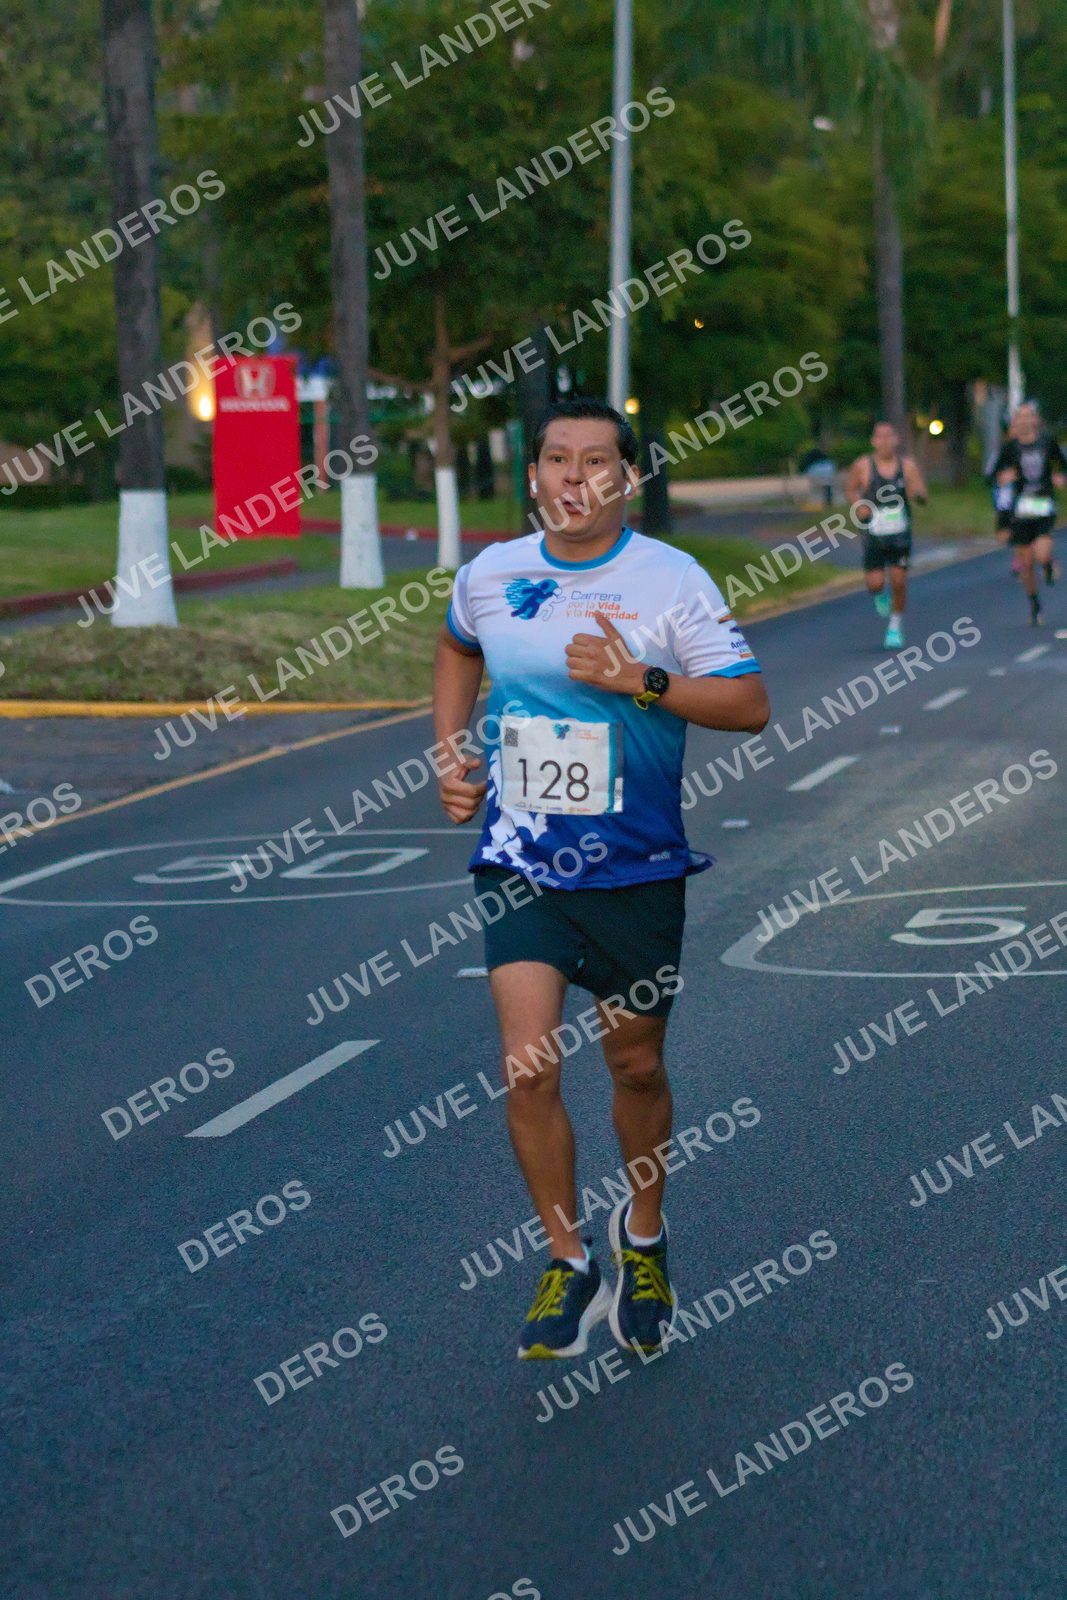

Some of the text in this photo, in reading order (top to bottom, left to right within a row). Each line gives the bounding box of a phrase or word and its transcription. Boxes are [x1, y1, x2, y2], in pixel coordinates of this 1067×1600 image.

[571, 590, 622, 602] Carrera
[598, 602, 621, 611] Vida
[585, 610, 639, 621] Ingridad
[518, 758, 590, 802] 128
[890, 906, 1027, 946] 5
